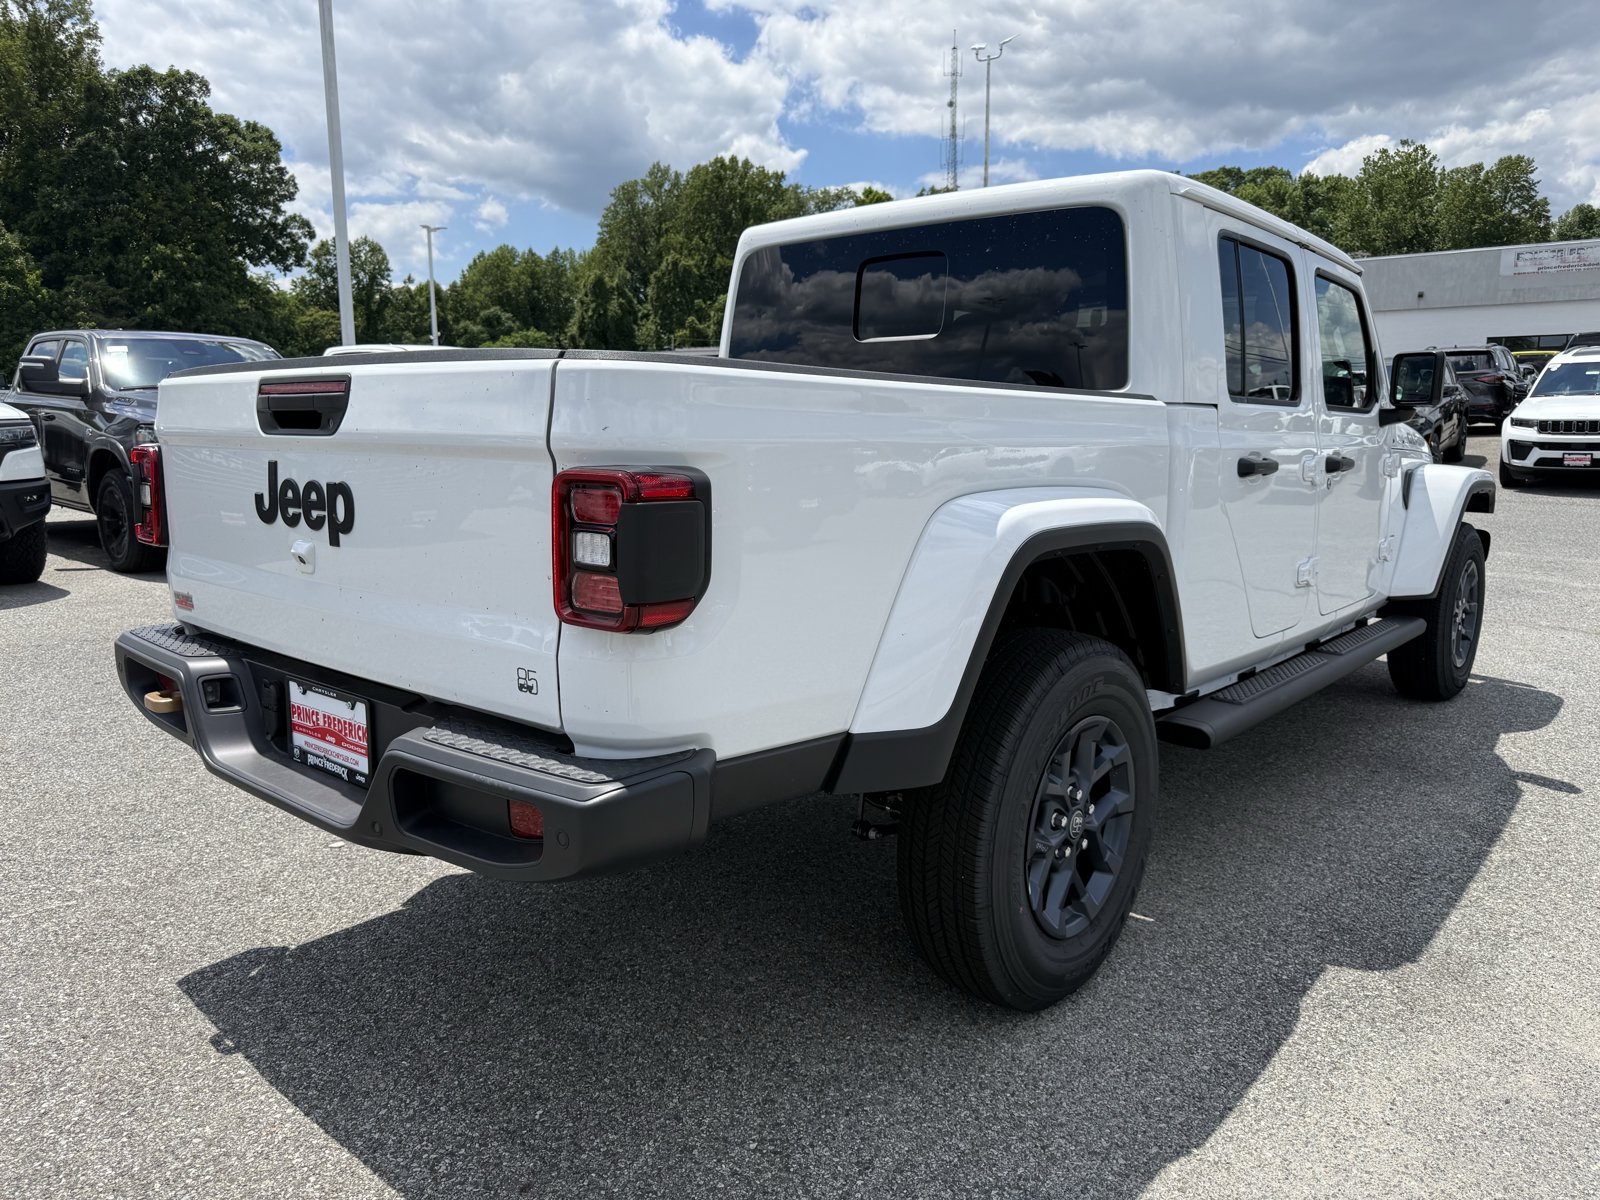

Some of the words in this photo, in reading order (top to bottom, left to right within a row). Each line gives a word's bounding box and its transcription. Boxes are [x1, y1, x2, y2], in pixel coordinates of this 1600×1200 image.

[254, 460, 355, 548] Jeep
[312, 687, 337, 697] CHRYSLER
[291, 703, 320, 726] PRINCE
[322, 714, 368, 745] FREDERICK
[325, 733, 336, 744] Jeep
[341, 741, 366, 753] DODGE
[307, 754, 323, 767] PRINCE
[323, 760, 349, 781] FREDERICK
[355, 773, 366, 784] Jeep
